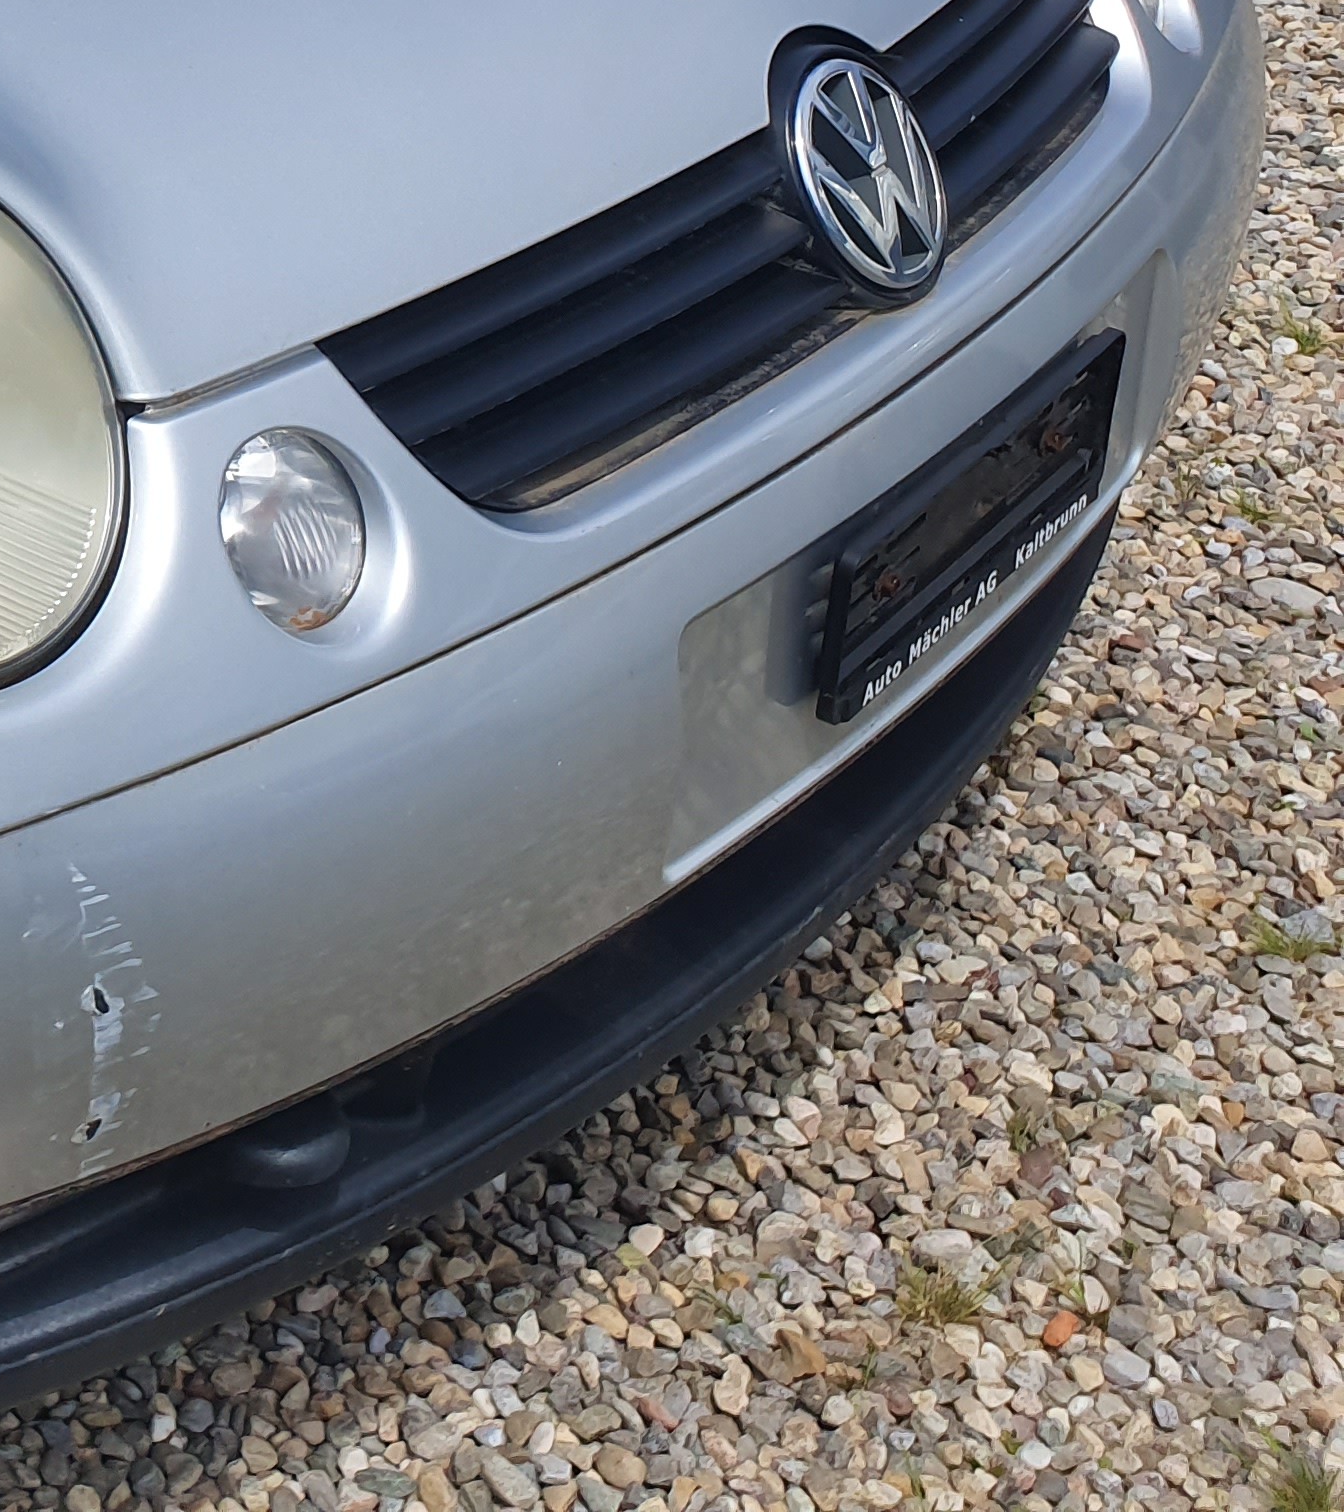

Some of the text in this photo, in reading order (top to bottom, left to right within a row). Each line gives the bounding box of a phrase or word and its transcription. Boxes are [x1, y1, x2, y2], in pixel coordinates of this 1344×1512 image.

[794, 58, 949, 289] VW
[862, 493, 1088, 707] Auto Mächler AG Kaltbrunn
